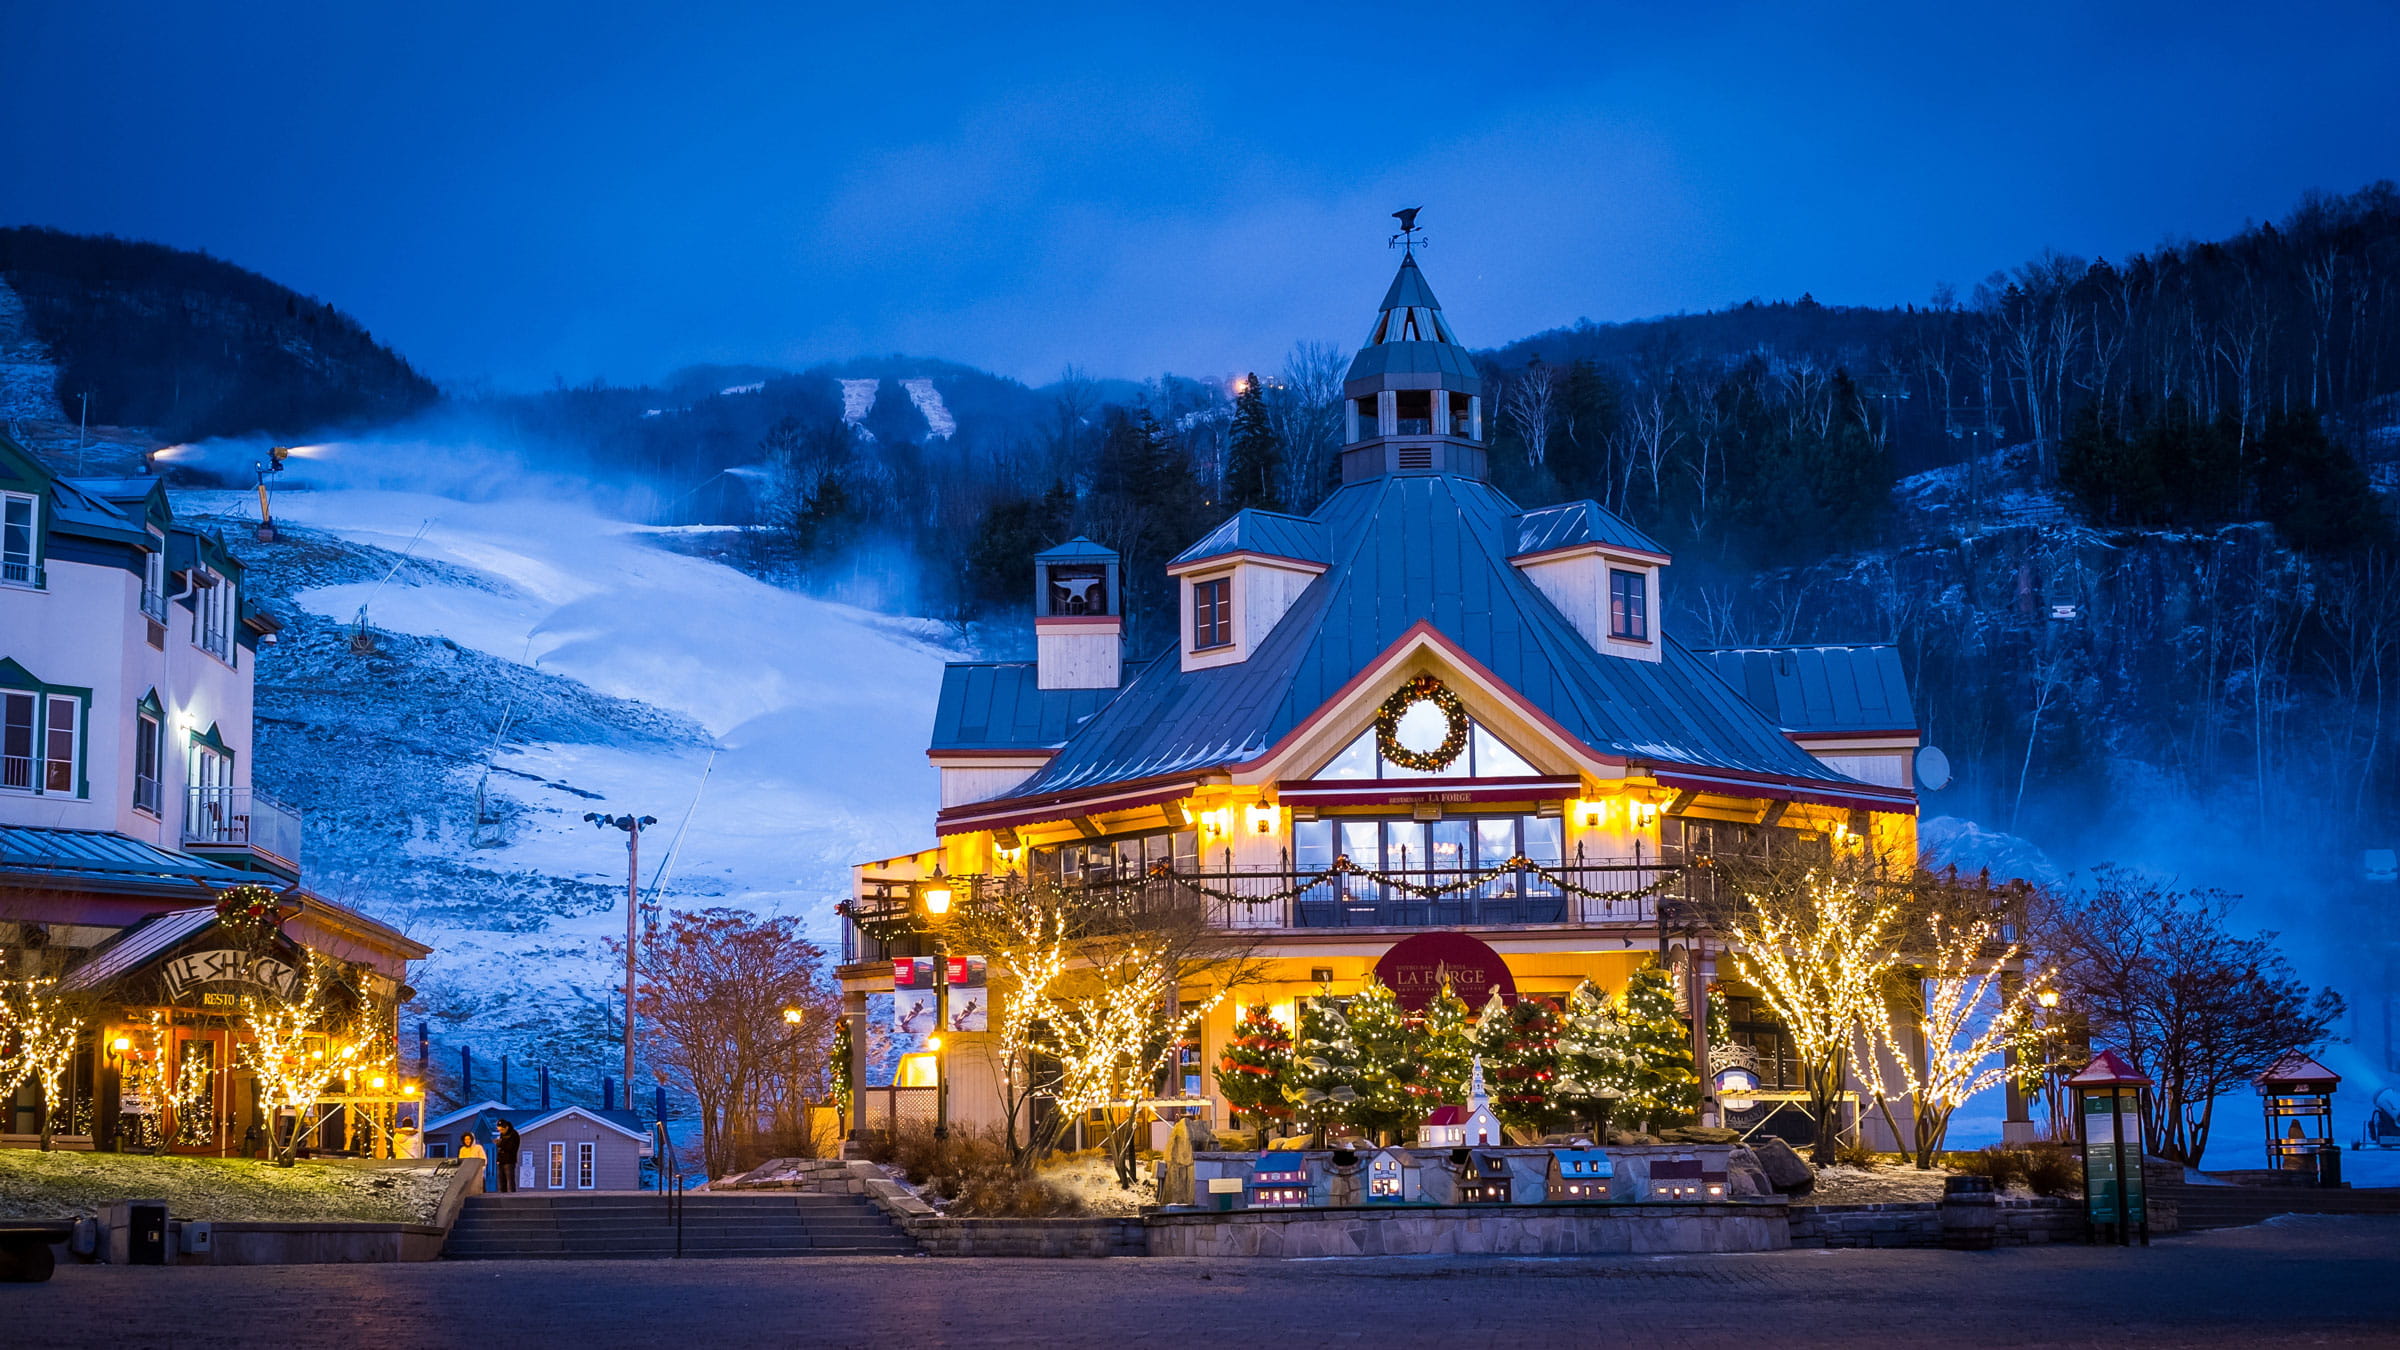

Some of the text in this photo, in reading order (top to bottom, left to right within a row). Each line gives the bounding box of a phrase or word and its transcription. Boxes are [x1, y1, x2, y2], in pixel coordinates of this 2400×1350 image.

[1428, 793, 1440, 802] LA
[1441, 792, 1472, 802] FORGE
[1397, 971, 1419, 985] LA
[204, 993, 235, 1006] RESTO
